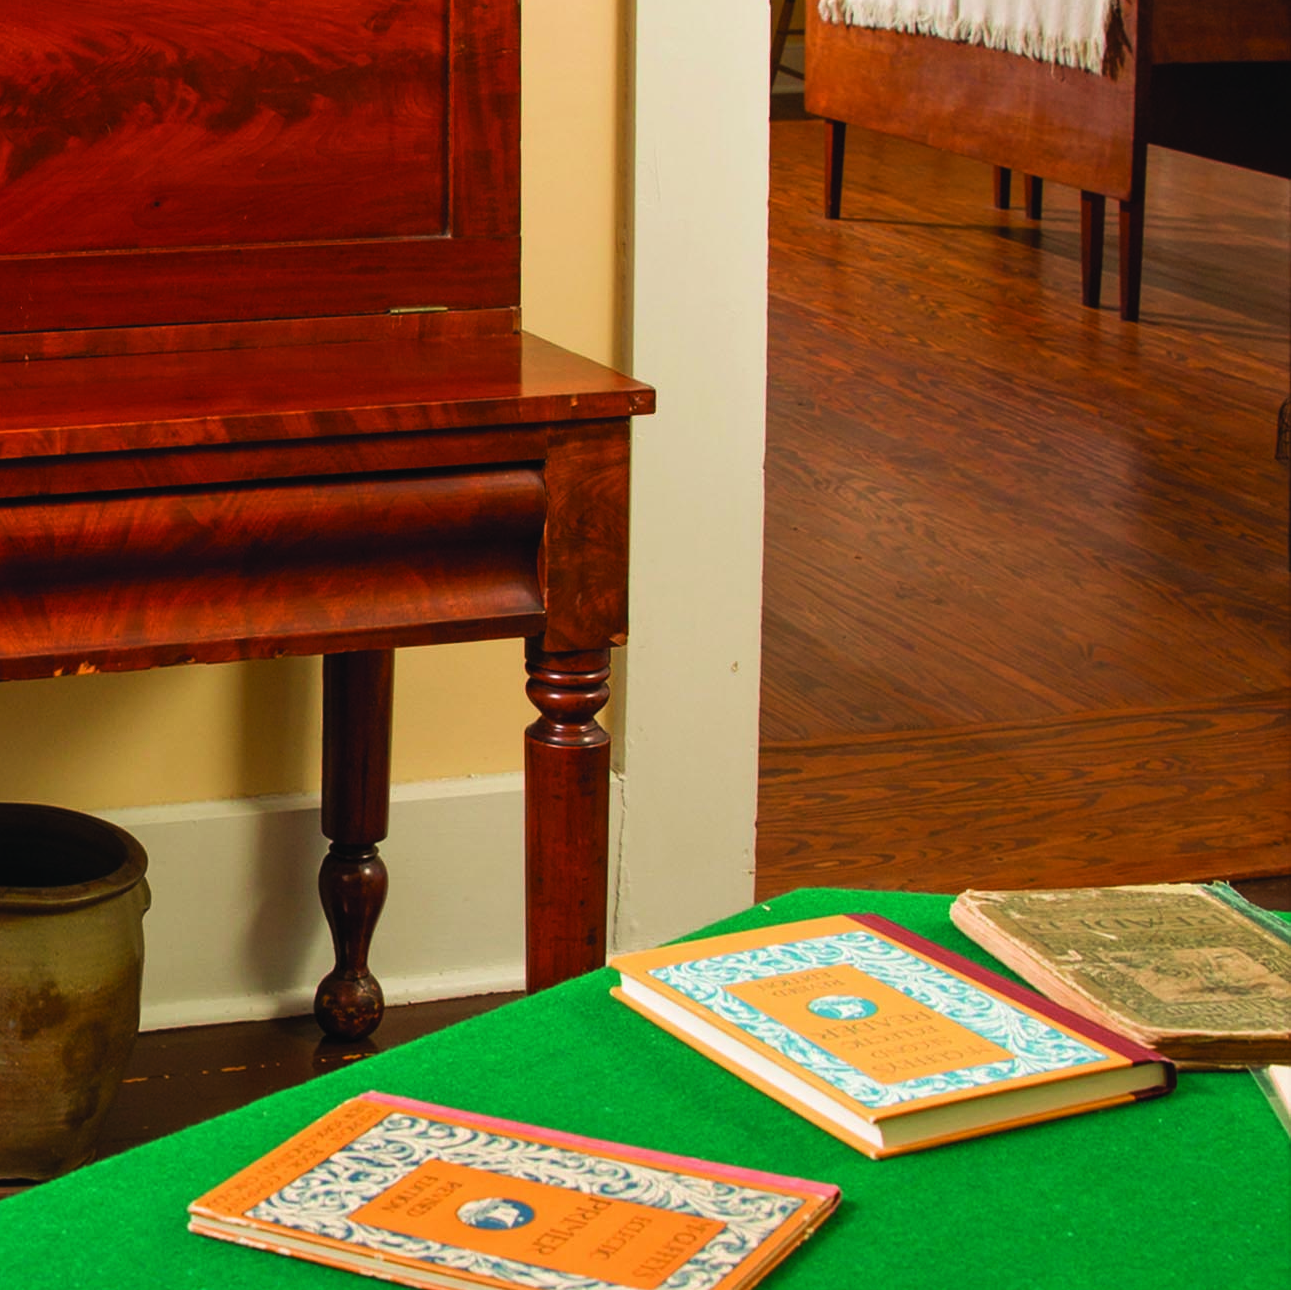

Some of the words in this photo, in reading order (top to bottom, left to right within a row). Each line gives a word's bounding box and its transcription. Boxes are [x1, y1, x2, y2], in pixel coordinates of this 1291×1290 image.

[814, 1010, 934, 1041] READER
[841, 1024, 940, 1050] ECLECTIC
[381, 1174, 439, 1213] EDITION
[406, 1180, 463, 1218] REVISED
[527, 1196, 612, 1256] PRIMER
[590, 1215, 653, 1260] ECLECTIC
